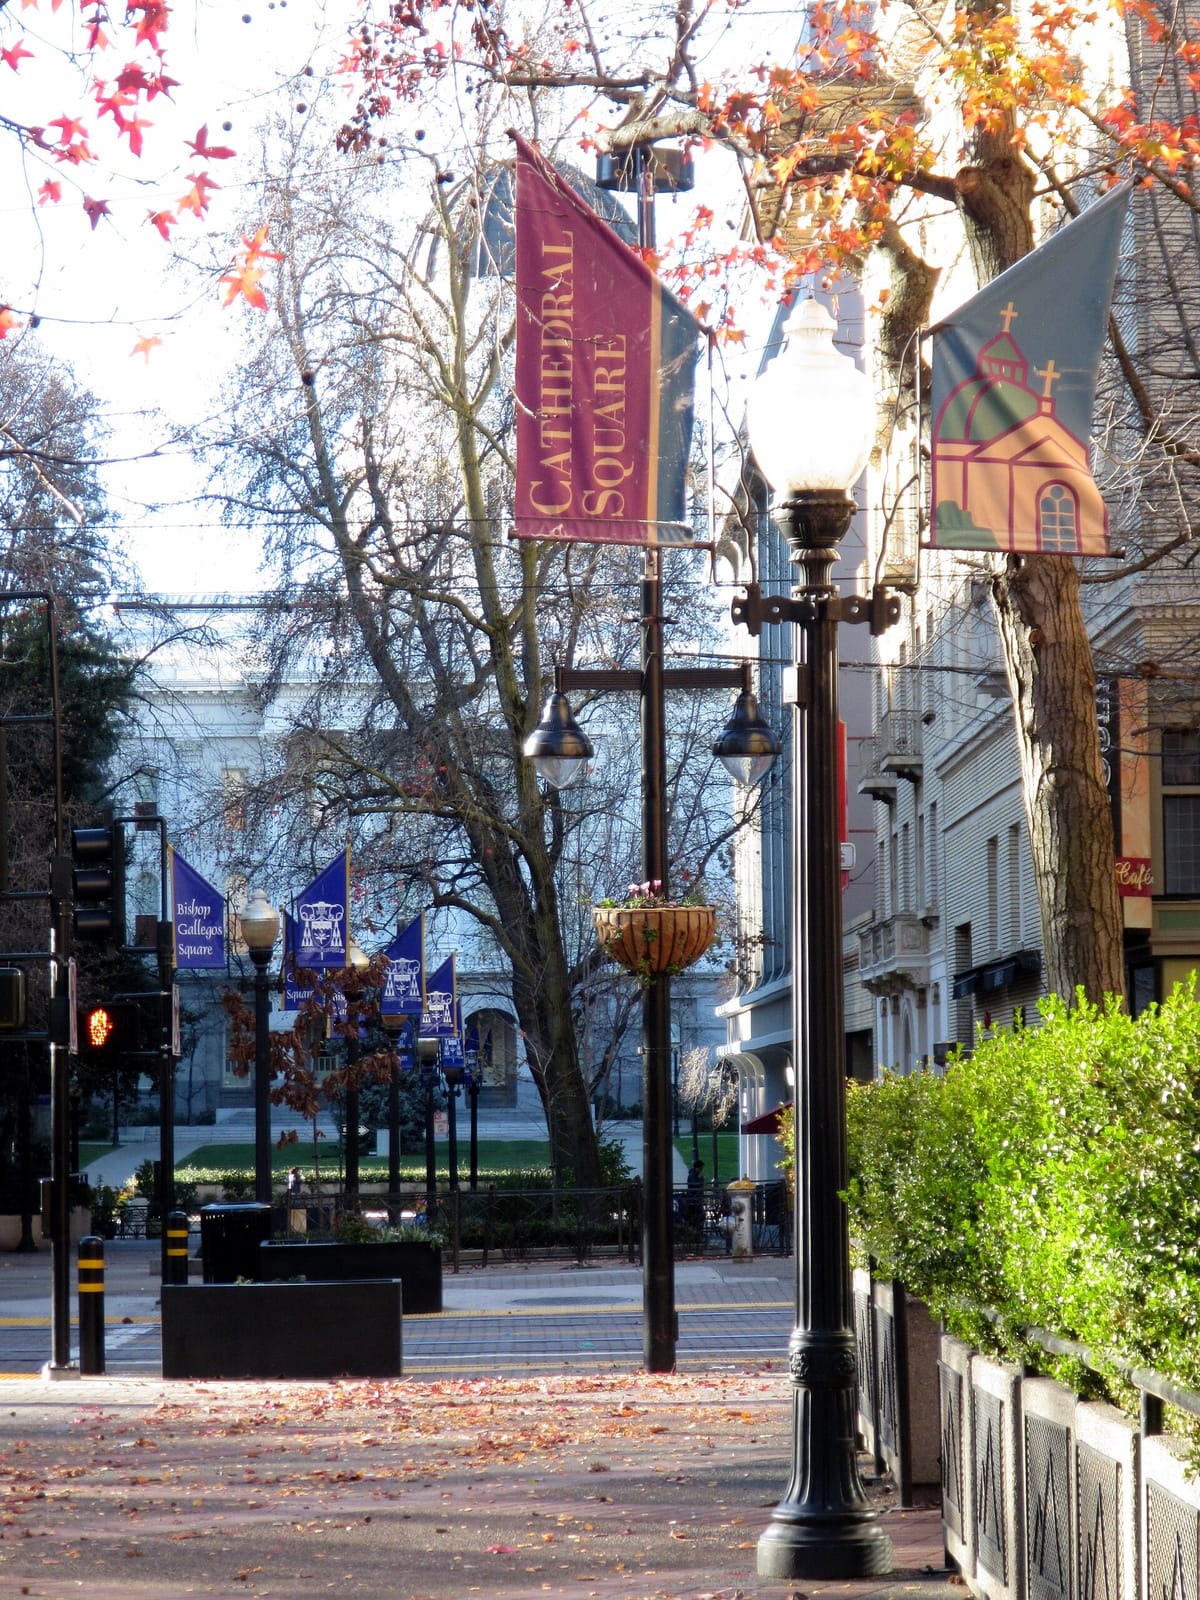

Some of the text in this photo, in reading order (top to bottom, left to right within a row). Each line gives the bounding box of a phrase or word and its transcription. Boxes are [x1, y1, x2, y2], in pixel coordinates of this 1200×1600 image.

[530, 230, 574, 516] CATHEDRAL
[583, 334, 633, 517] SQUARE
[1115, 861, 1154, 891] Café
[177, 898, 211, 920] Bishop
[177, 918, 223, 940] Gallegos
[178, 943, 213, 960] Square
[286, 989, 314, 1003] Squar
